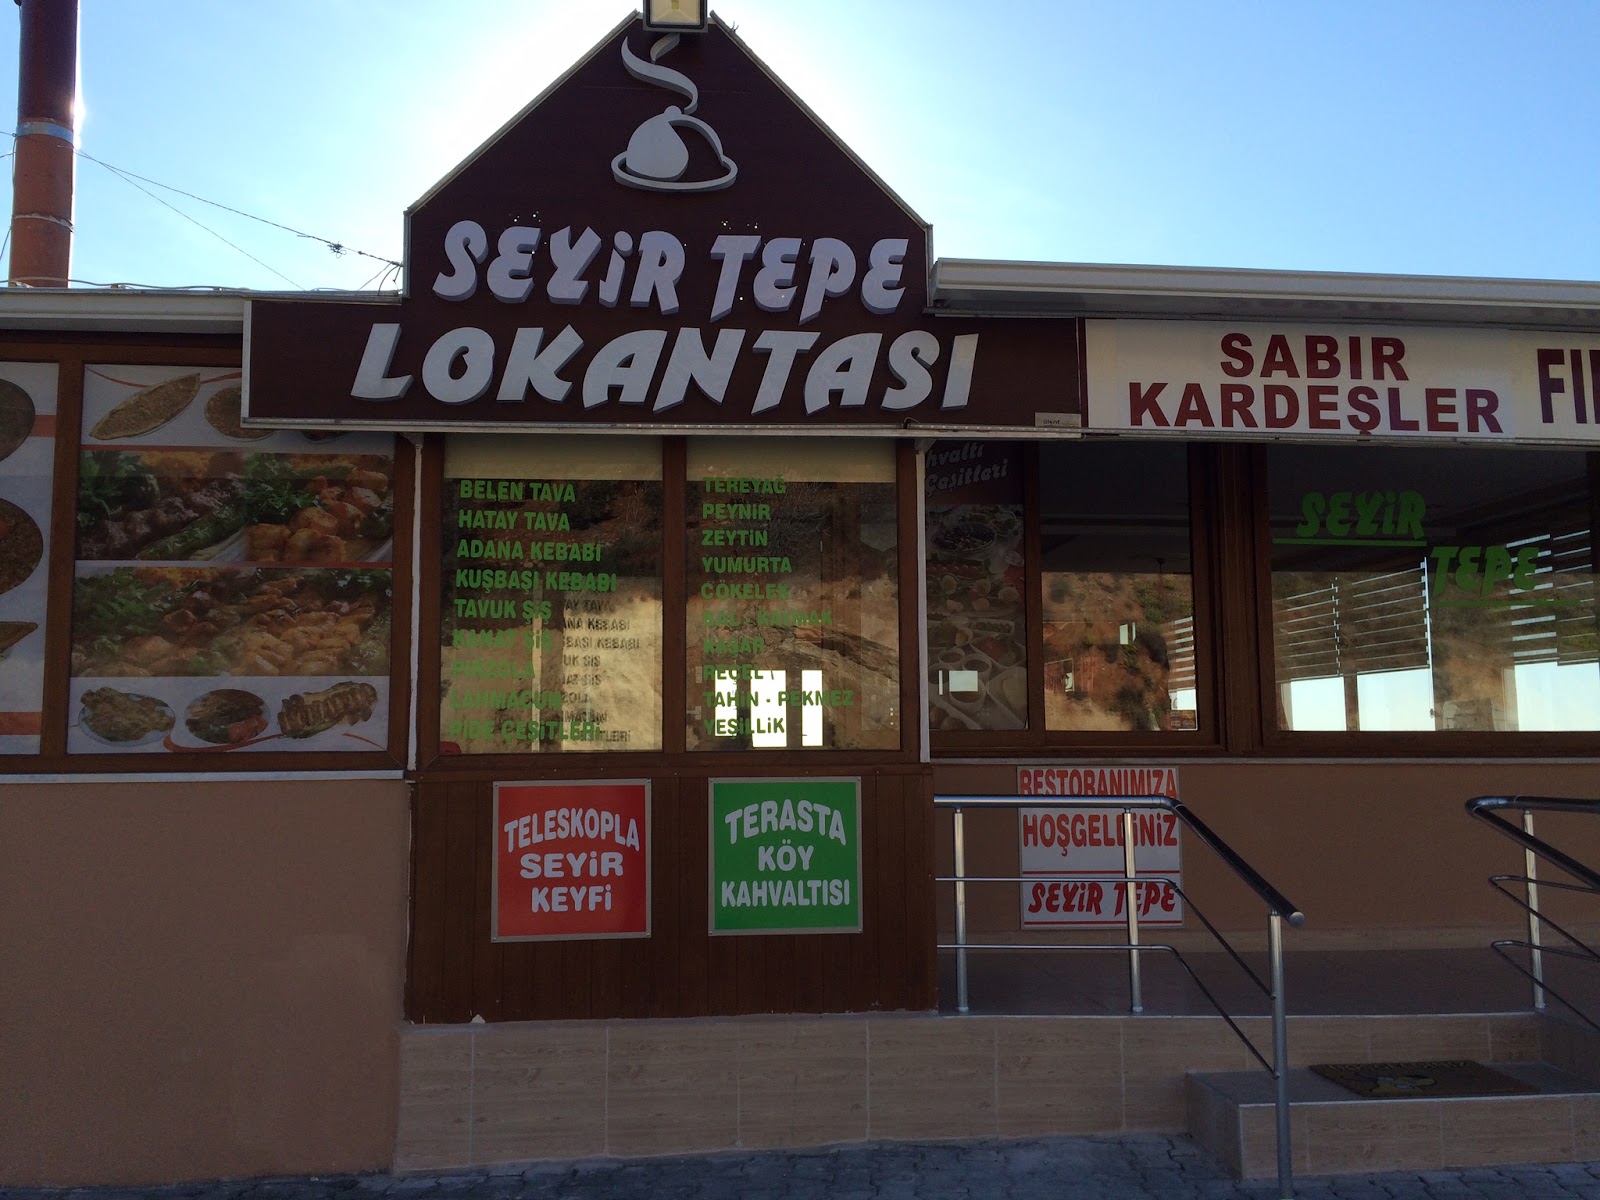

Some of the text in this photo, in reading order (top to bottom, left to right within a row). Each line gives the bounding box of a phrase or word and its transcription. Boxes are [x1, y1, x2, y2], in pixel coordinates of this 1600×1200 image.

[710, 234, 909, 325] TEPE
[350, 322, 980, 416] LOKANTASI
[1219, 332, 1410, 381] SABIR
[1537, 348, 1600, 424] FI
[1128, 382, 1504, 436] KARDEŞLER
[459, 479, 576, 502] BELEN TAVA
[702, 475, 787, 494] TEREYAĞ
[458, 509, 571, 531] HATAY TAVA
[456, 539, 601, 562] ADANA KEBABI
[702, 556, 792, 573] YUMURTA
[1429, 545, 1541, 598] TEPE
[455, 568, 617, 594] KUŞBAŞI KEBABI
[454, 598, 517, 619] TAVUK
[703, 610, 740, 627] BAL
[757, 609, 833, 627] KAYMAK
[703, 636, 765, 658] KAŞAR
[450, 690, 563, 710] LAHMACUN
[777, 689, 854, 707] PEKMEZ
[1019, 769, 1177, 798] RESTORANIMIZA
[504, 807, 640, 853] TELESKOPLA
[724, 798, 847, 846] TERASTA
[757, 839, 814, 871] KÖY
[721, 878, 850, 908] KAHVALTISI
